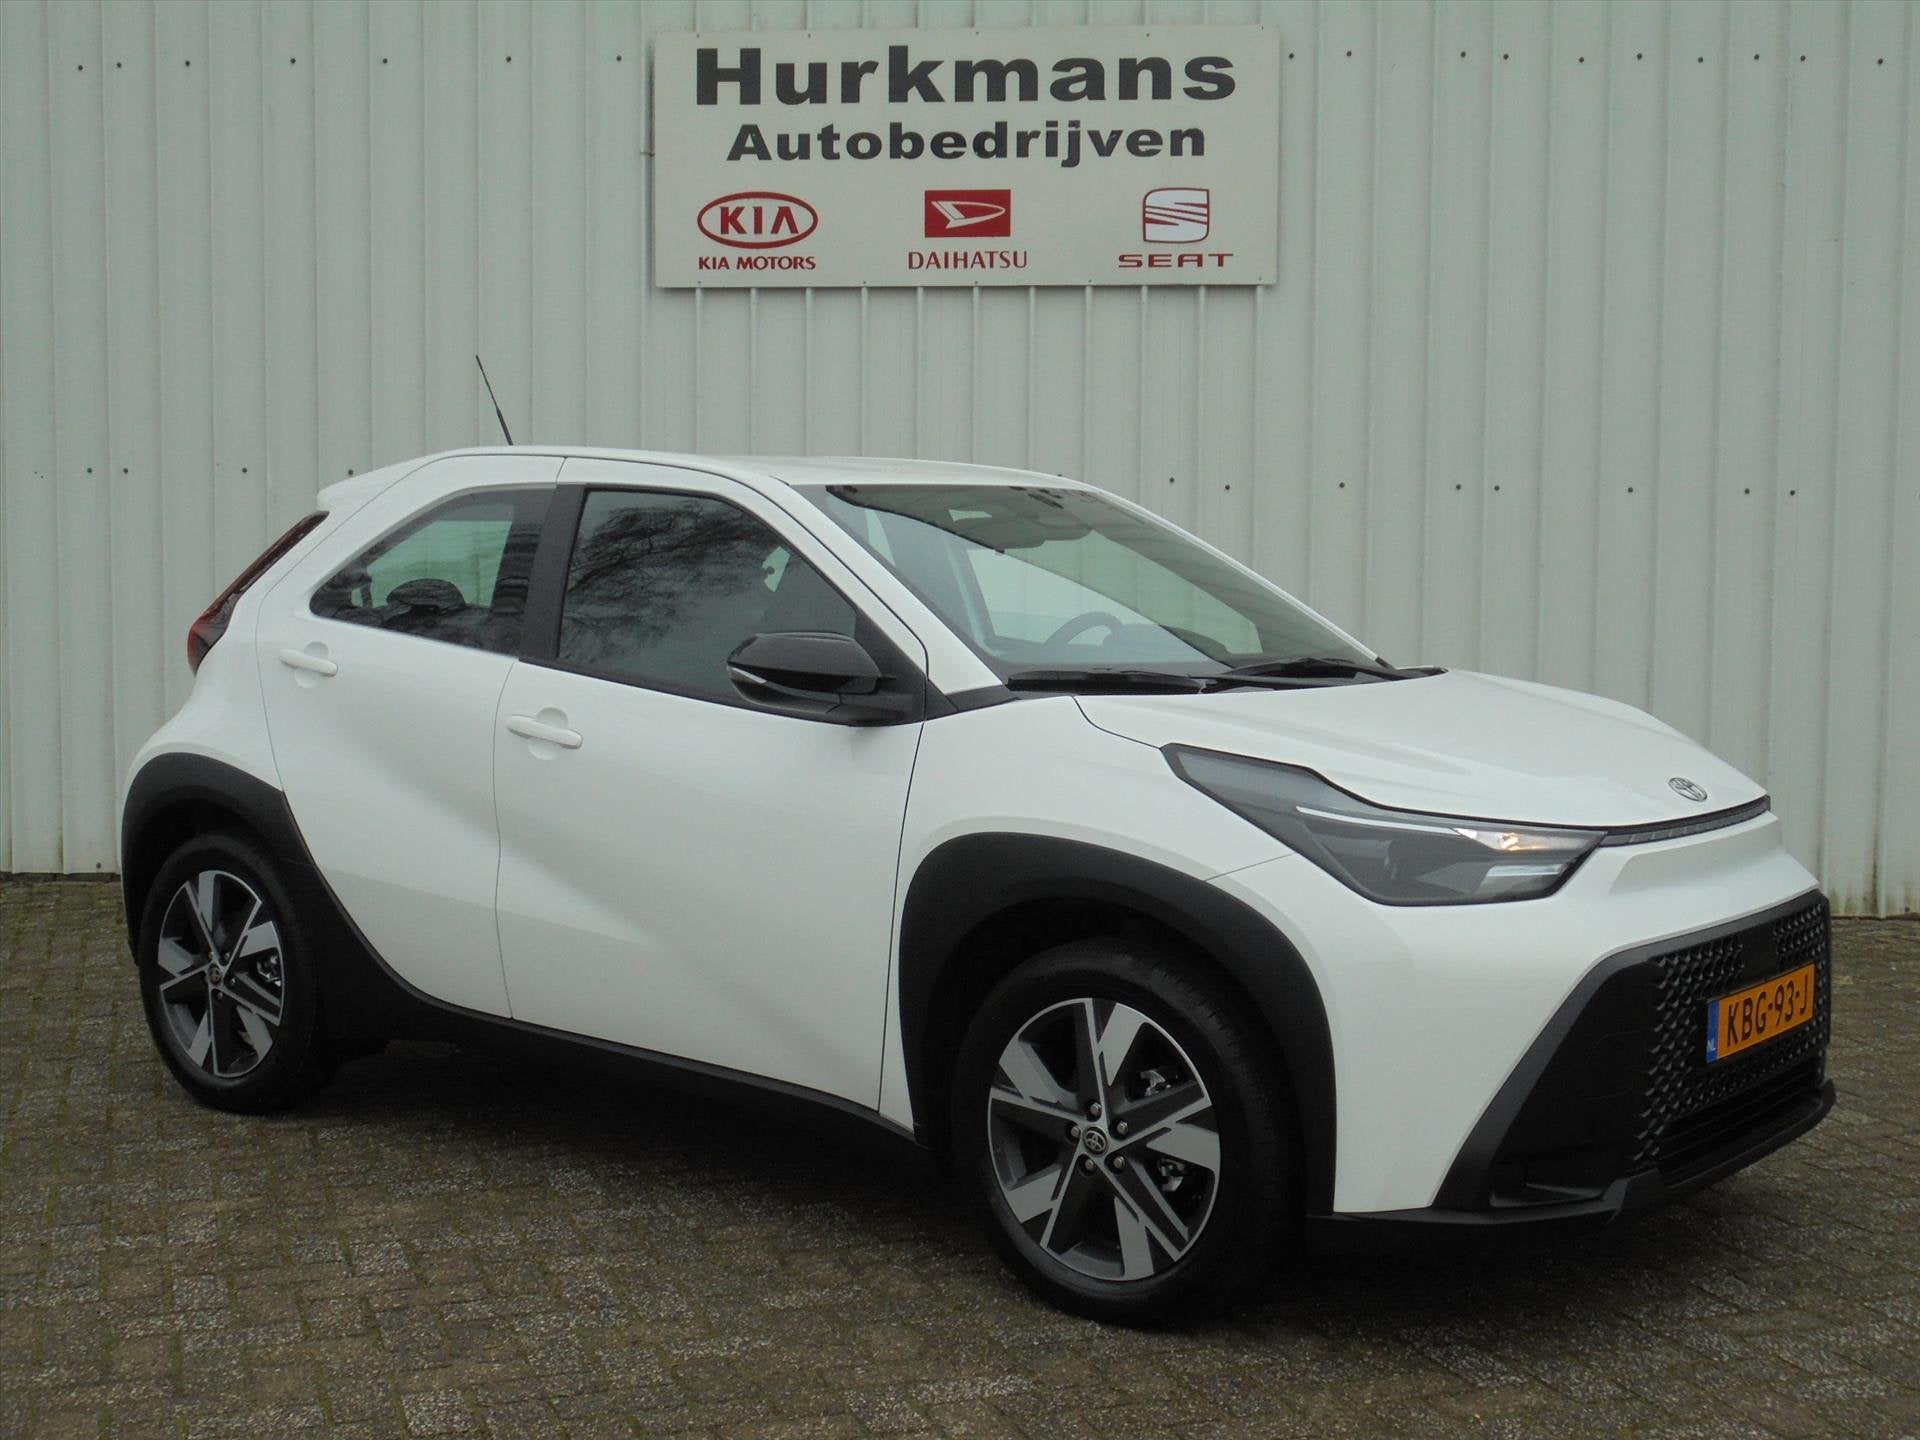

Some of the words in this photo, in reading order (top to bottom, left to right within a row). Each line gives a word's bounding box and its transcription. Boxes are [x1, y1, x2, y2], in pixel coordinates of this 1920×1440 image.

[696, 45, 1236, 105] Hurkmans
[726, 120, 1206, 169] Autobedrijven
[720, 206, 799, 235] KIA
[698, 257, 730, 270] KIA
[735, 256, 817, 270] MOTORS
[908, 250, 1028, 270] DAIHATSU
[1118, 253, 1235, 268] SEAT
[1727, 973, 1809, 1047] KBG-93-J
